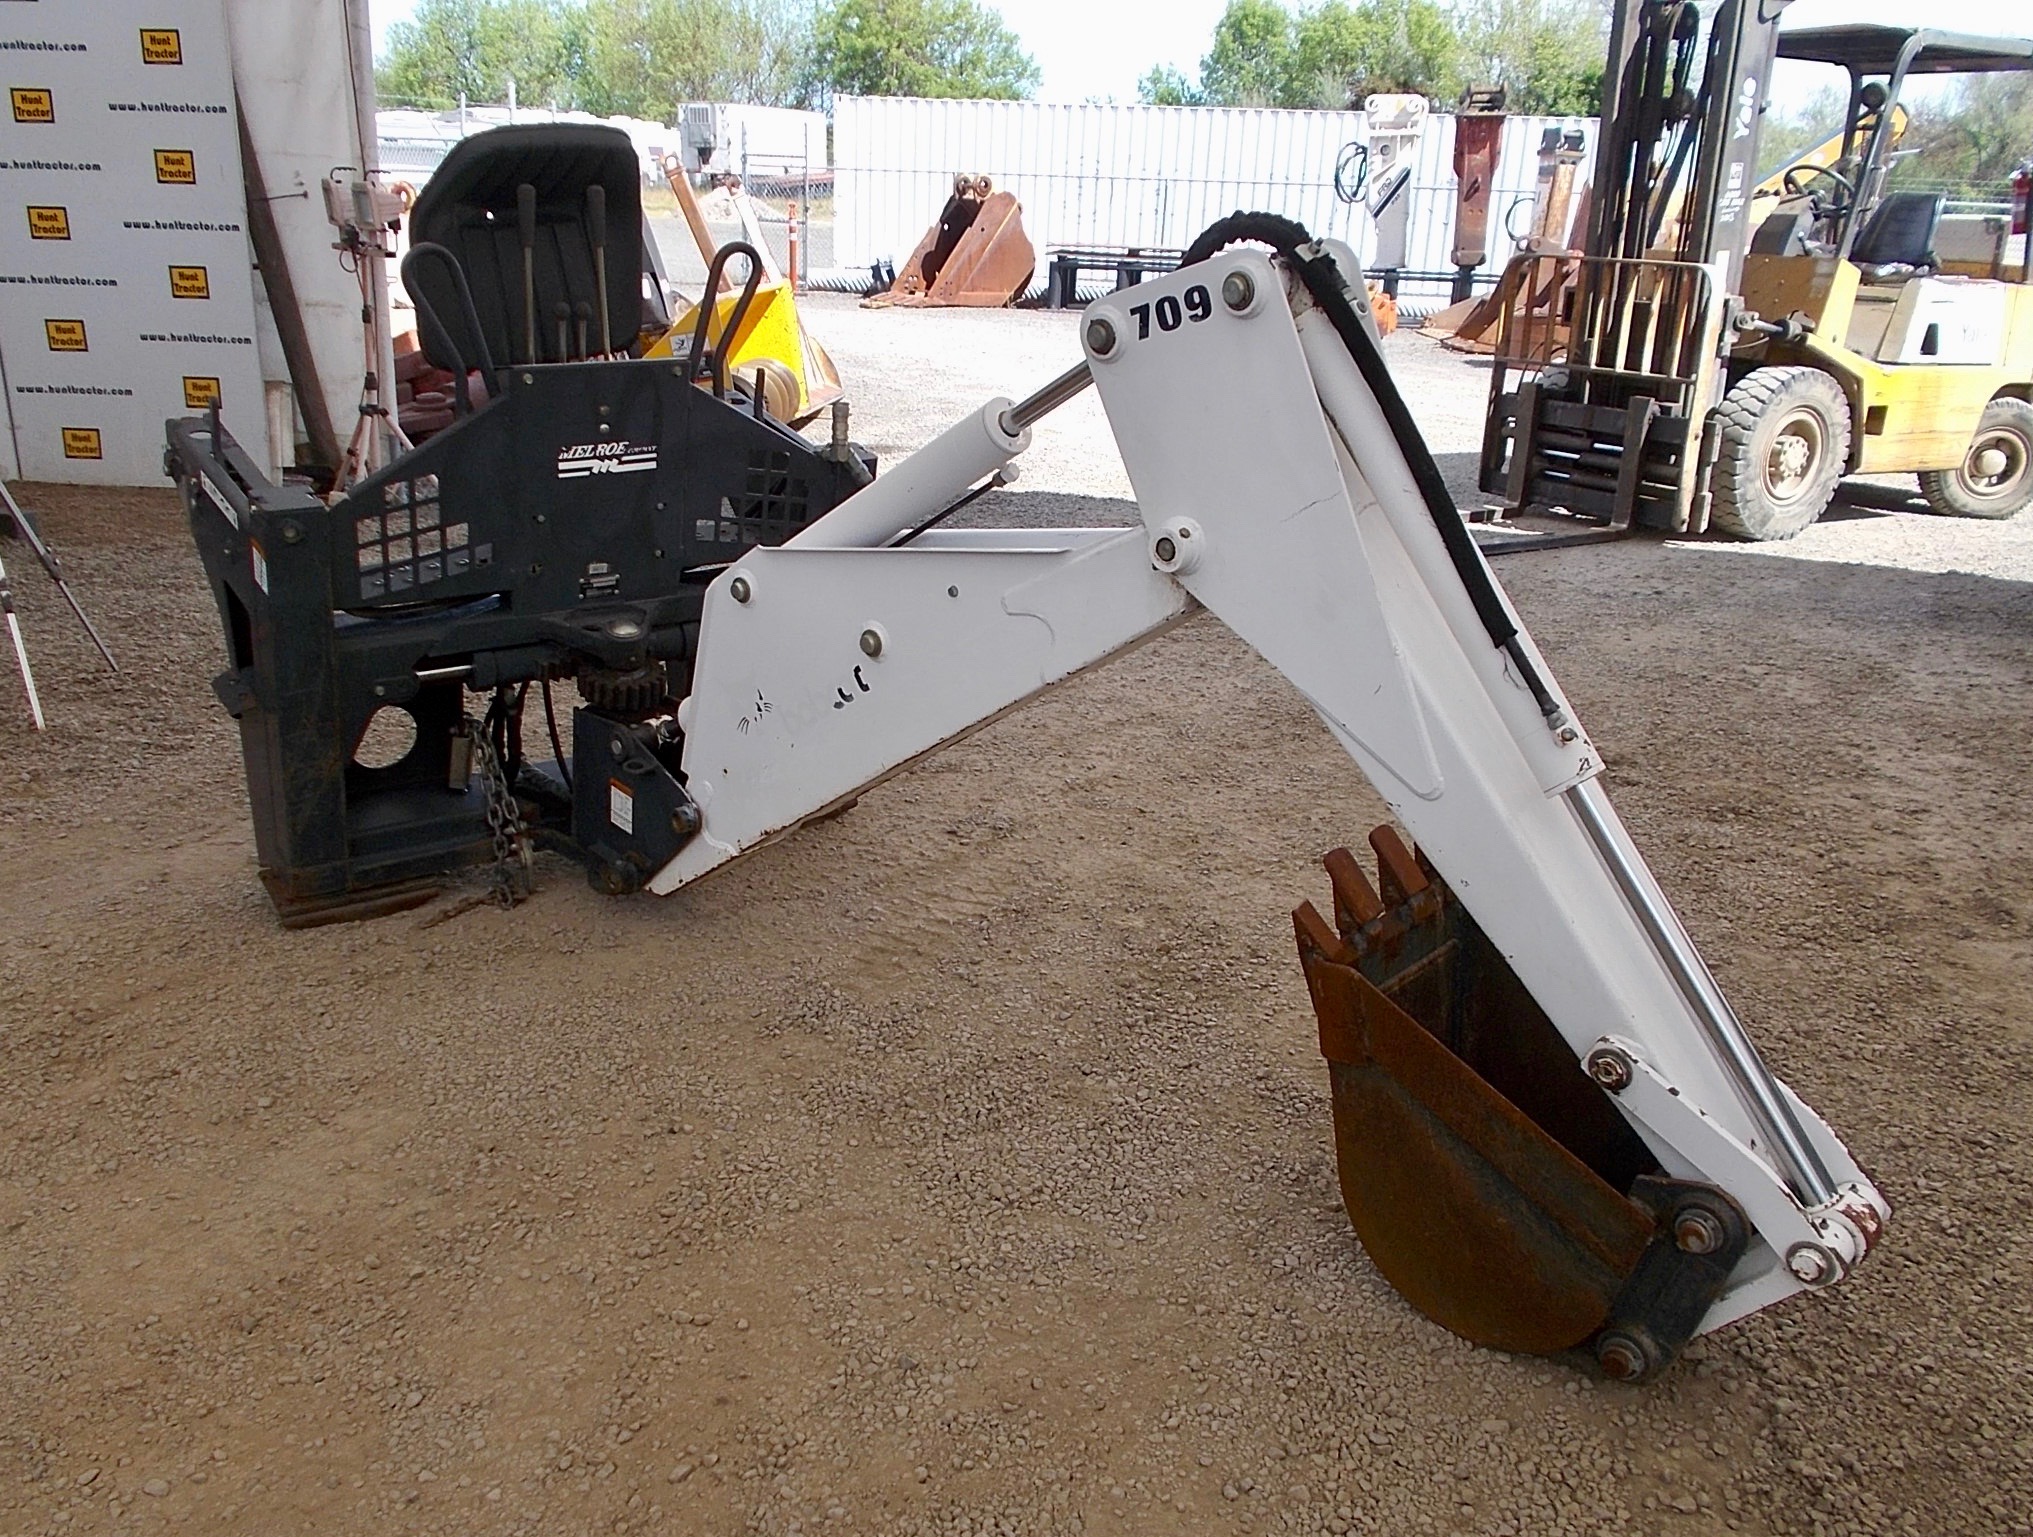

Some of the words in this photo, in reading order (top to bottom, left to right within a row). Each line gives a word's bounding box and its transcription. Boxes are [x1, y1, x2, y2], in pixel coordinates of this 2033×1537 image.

[150, 35, 171, 46] Hunt
[145, 48, 178, 59] Tractor
[20, 94, 43, 105] Hunt
[16, 106, 50, 117] Tractor
[108, 102, 227, 113] www.hunttractor.com
[1733, 77, 1757, 139] Yale
[163, 155, 185, 166] Hunt
[159, 168, 192, 178] Tractor
[37, 212, 58, 222] Hunt
[32, 224, 66, 234] Tractor
[123, 220, 240, 232] www.hunttractor.com
[0, 275, 117, 286] www.hunttractor.com
[178, 271, 199, 281] Hunt
[174, 283, 206, 293] Tractor
[1129, 284, 1212, 341] 709
[54, 325, 76, 334] Hunt
[50, 336, 84, 346] Tractor
[139, 333, 252, 345] www.hunttractor.com
[16, 385, 133, 396] www.hunttractor.com
[191, 382, 211, 392] Hunt
[71, 433, 92, 442] Hunt
[67, 443, 98, 454] Tractor
[559, 442, 629, 459] MELROE
